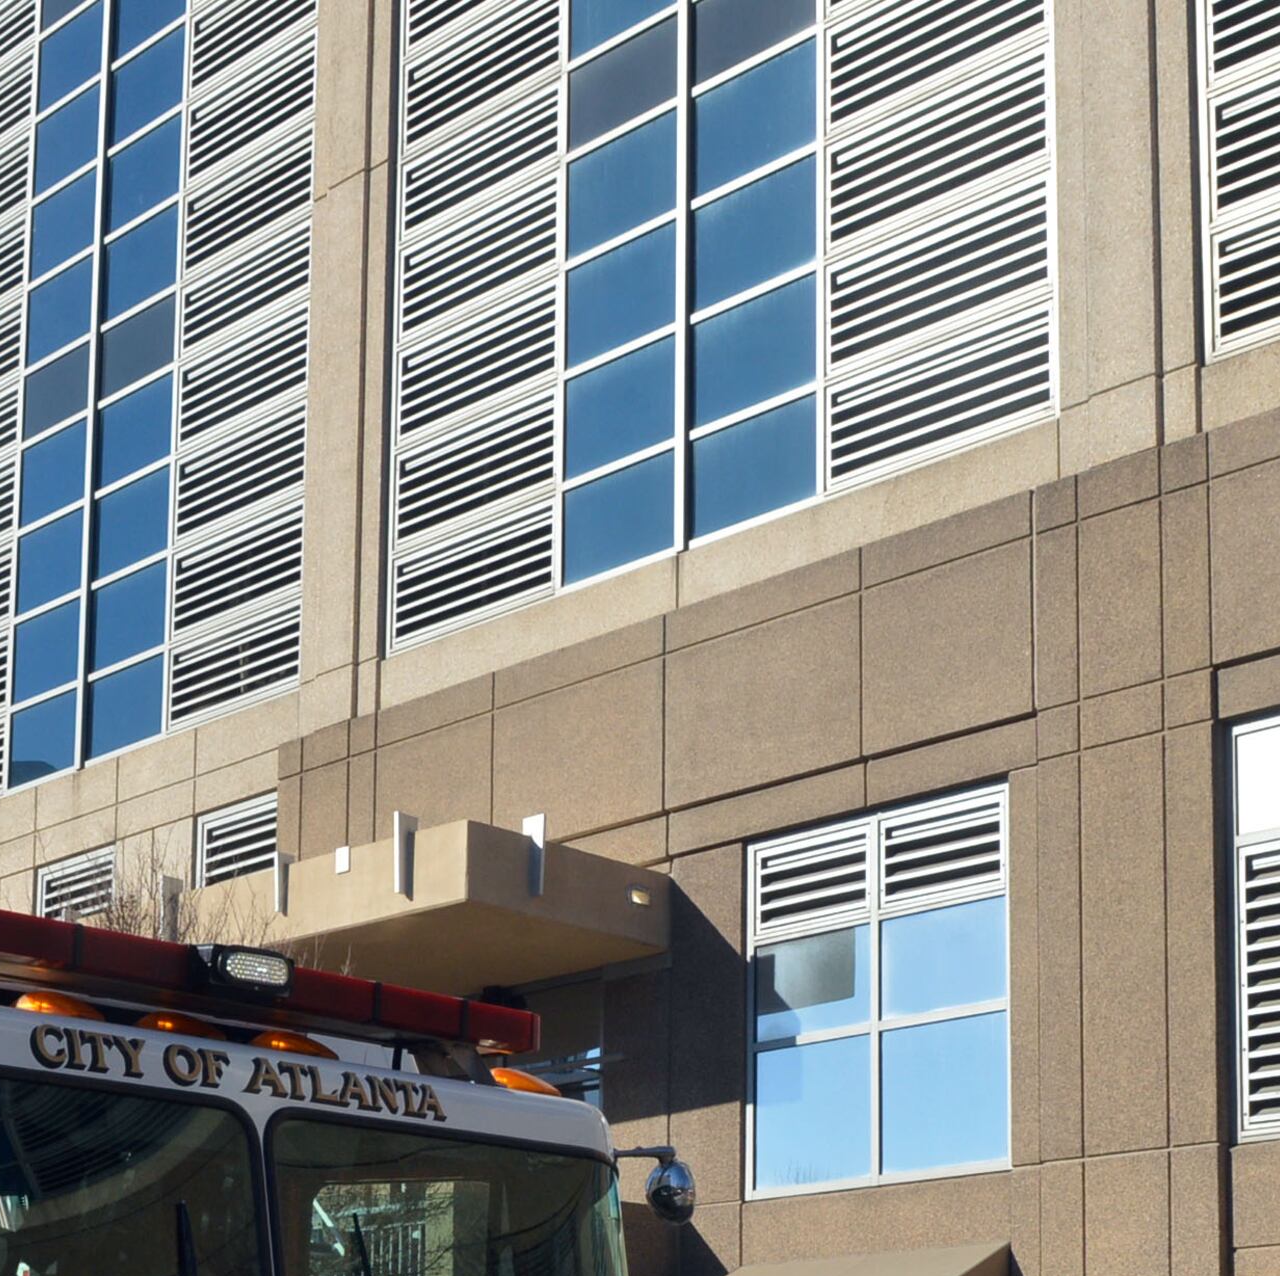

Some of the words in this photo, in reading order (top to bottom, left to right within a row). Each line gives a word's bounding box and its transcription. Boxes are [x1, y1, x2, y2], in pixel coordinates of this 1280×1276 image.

[30, 1023, 146, 1078] CITY
[163, 1042, 230, 1088] OF
[244, 1057, 447, 1121] ATLANTA
